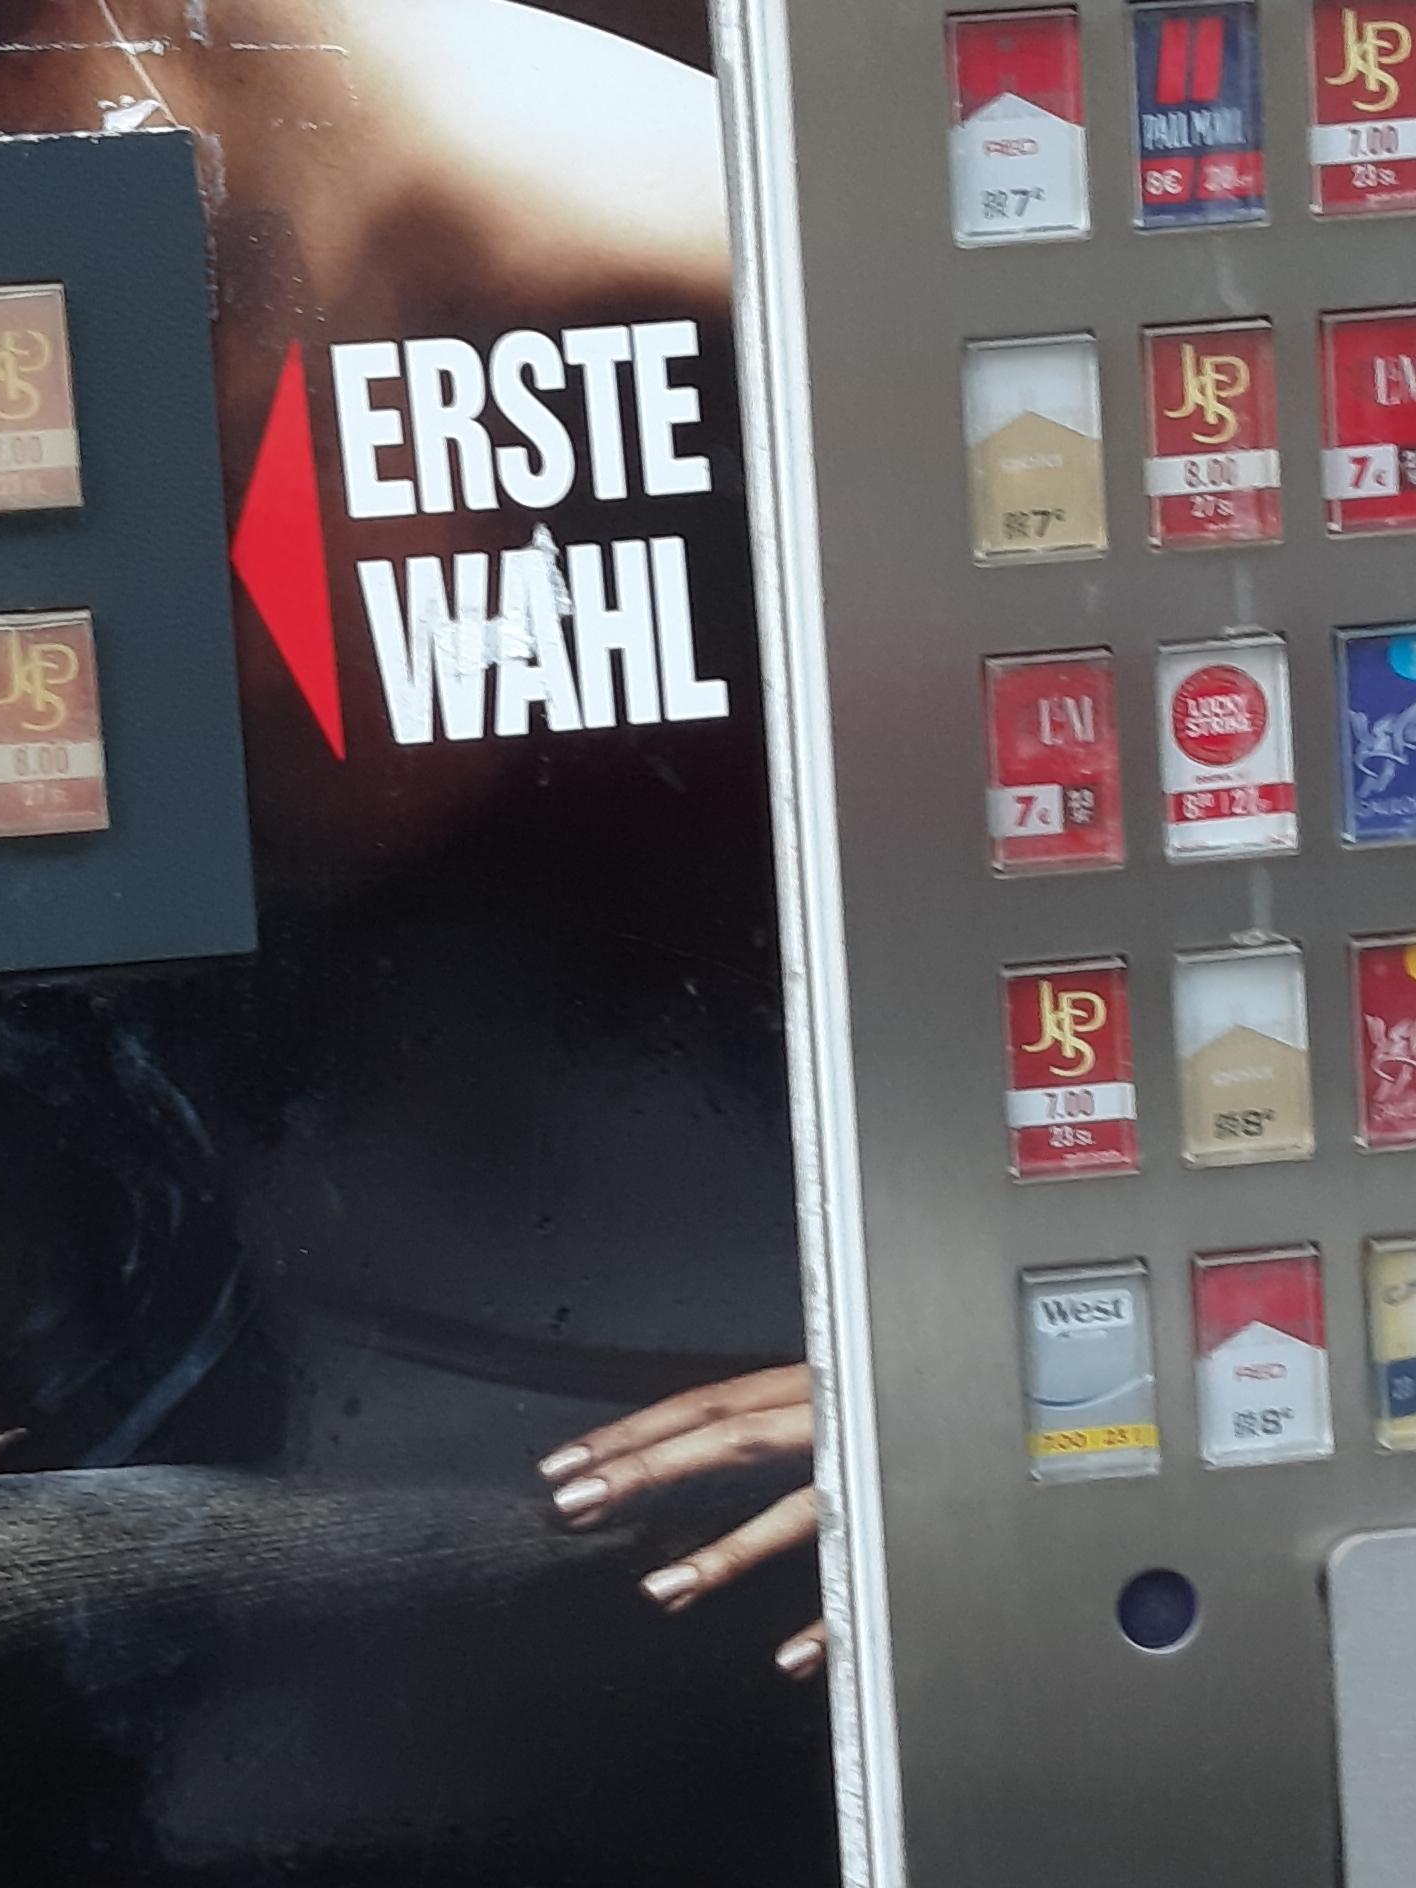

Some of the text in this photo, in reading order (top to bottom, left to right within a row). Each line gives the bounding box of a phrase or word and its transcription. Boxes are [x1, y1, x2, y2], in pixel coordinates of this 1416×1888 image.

[330, 320, 712, 520] ERSTE
[356, 536, 730, 746] WAHL
[1040, 1299, 1124, 1326] West
